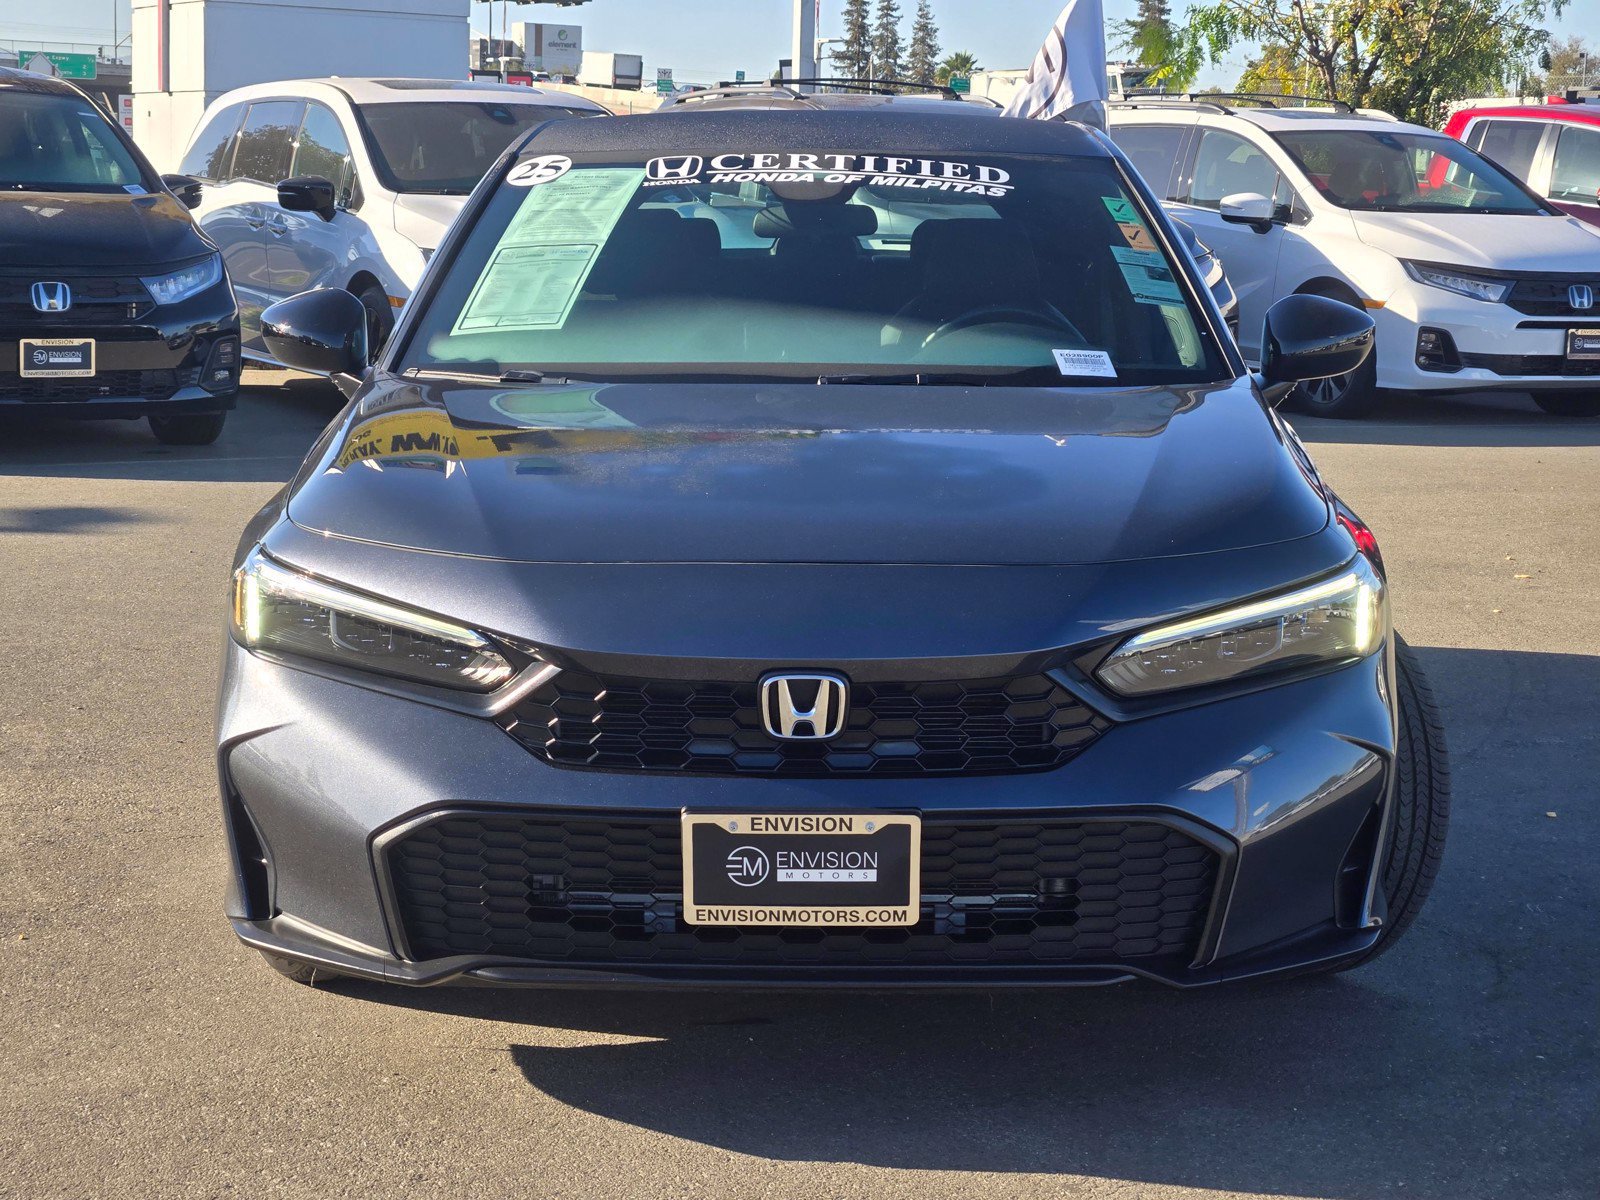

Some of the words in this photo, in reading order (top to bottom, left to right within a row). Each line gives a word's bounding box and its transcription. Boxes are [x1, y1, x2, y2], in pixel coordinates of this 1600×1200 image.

[510, 158, 569, 182] 25
[710, 152, 1011, 184] CERTIFIED
[642, 178, 702, 187] HONDA
[710, 172, 815, 183] HONDA
[823, 174, 866, 184] OF
[869, 175, 1008, 198] MILPITAS
[750, 817, 853, 832] ENVISION
[776, 851, 878, 869] ENVISION
[785, 871, 869, 880] MOTORS
[696, 909, 908, 923] ENVISIONMOTORS.COM
